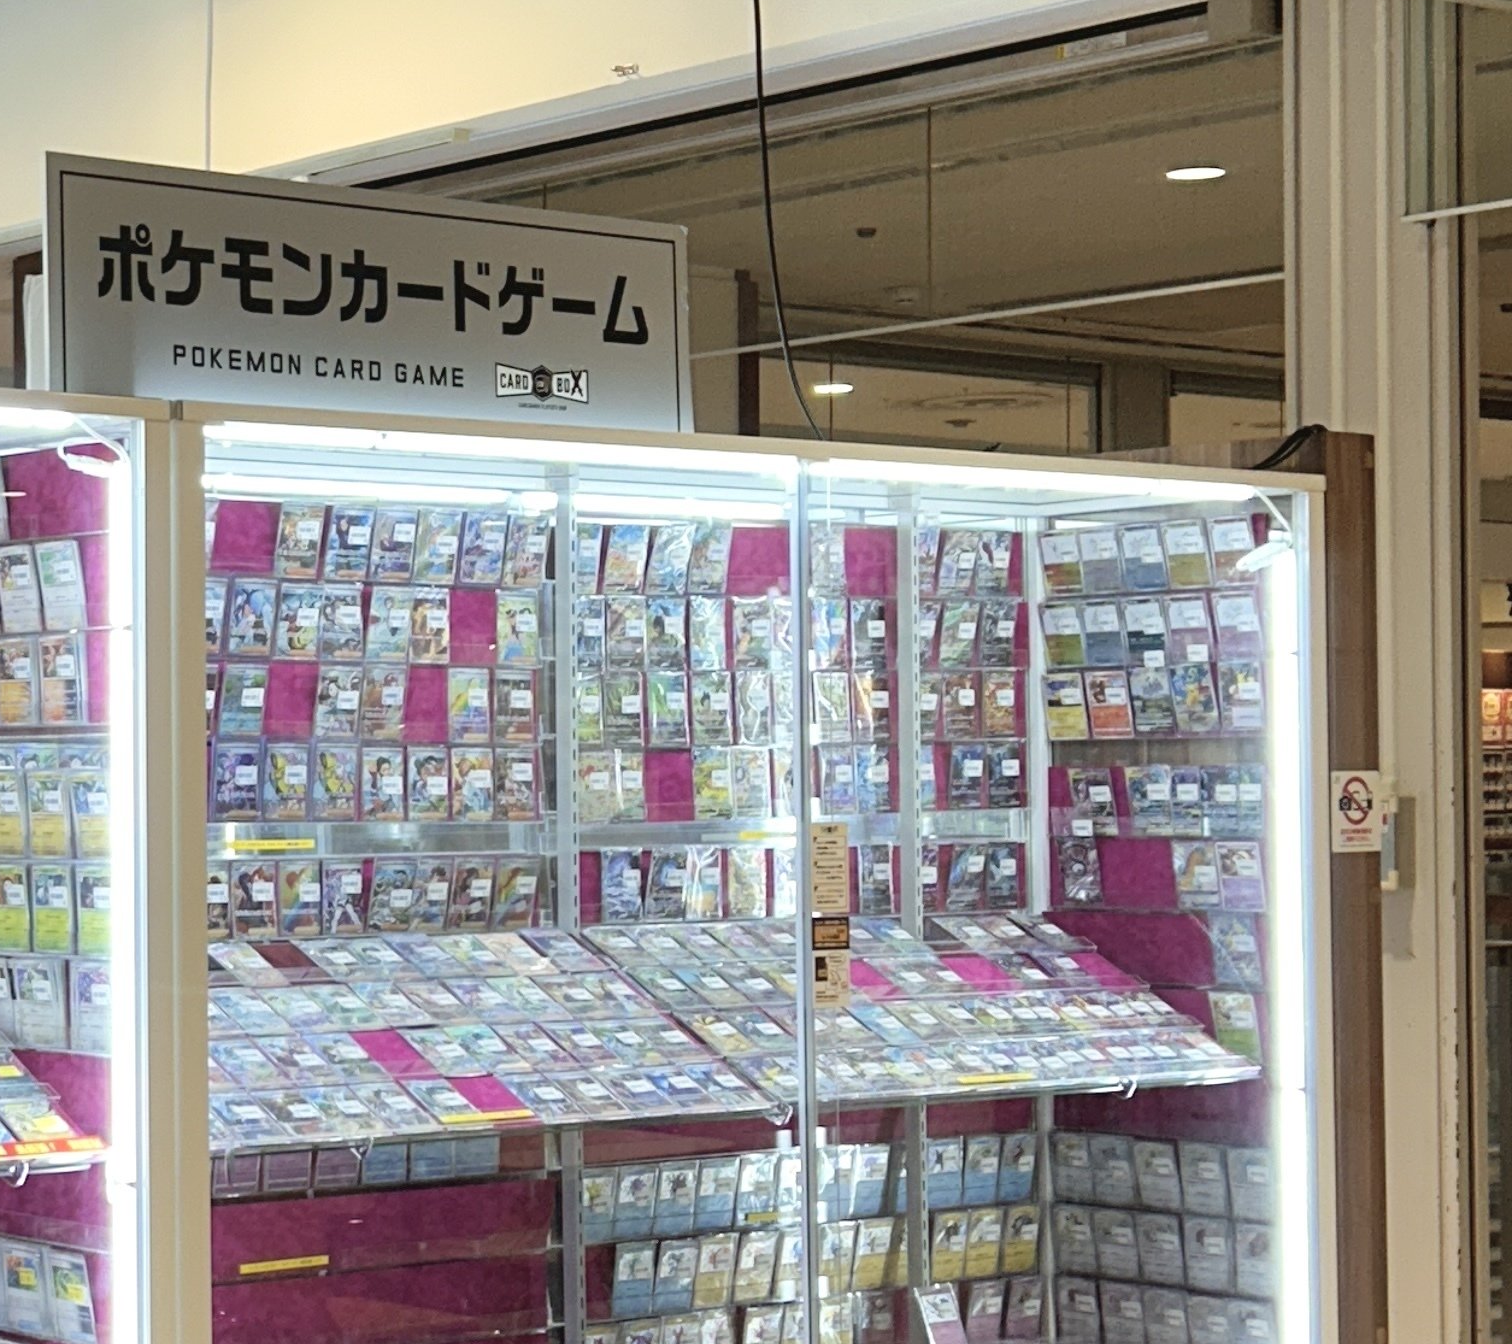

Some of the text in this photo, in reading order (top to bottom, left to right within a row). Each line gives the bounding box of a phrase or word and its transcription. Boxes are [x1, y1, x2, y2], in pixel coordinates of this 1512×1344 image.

[97, 222, 650, 346] ポケモンカードゲーム
[172, 344, 465, 388] POKEMON CARD GAME
[499, 368, 584, 397] CARD BOX
